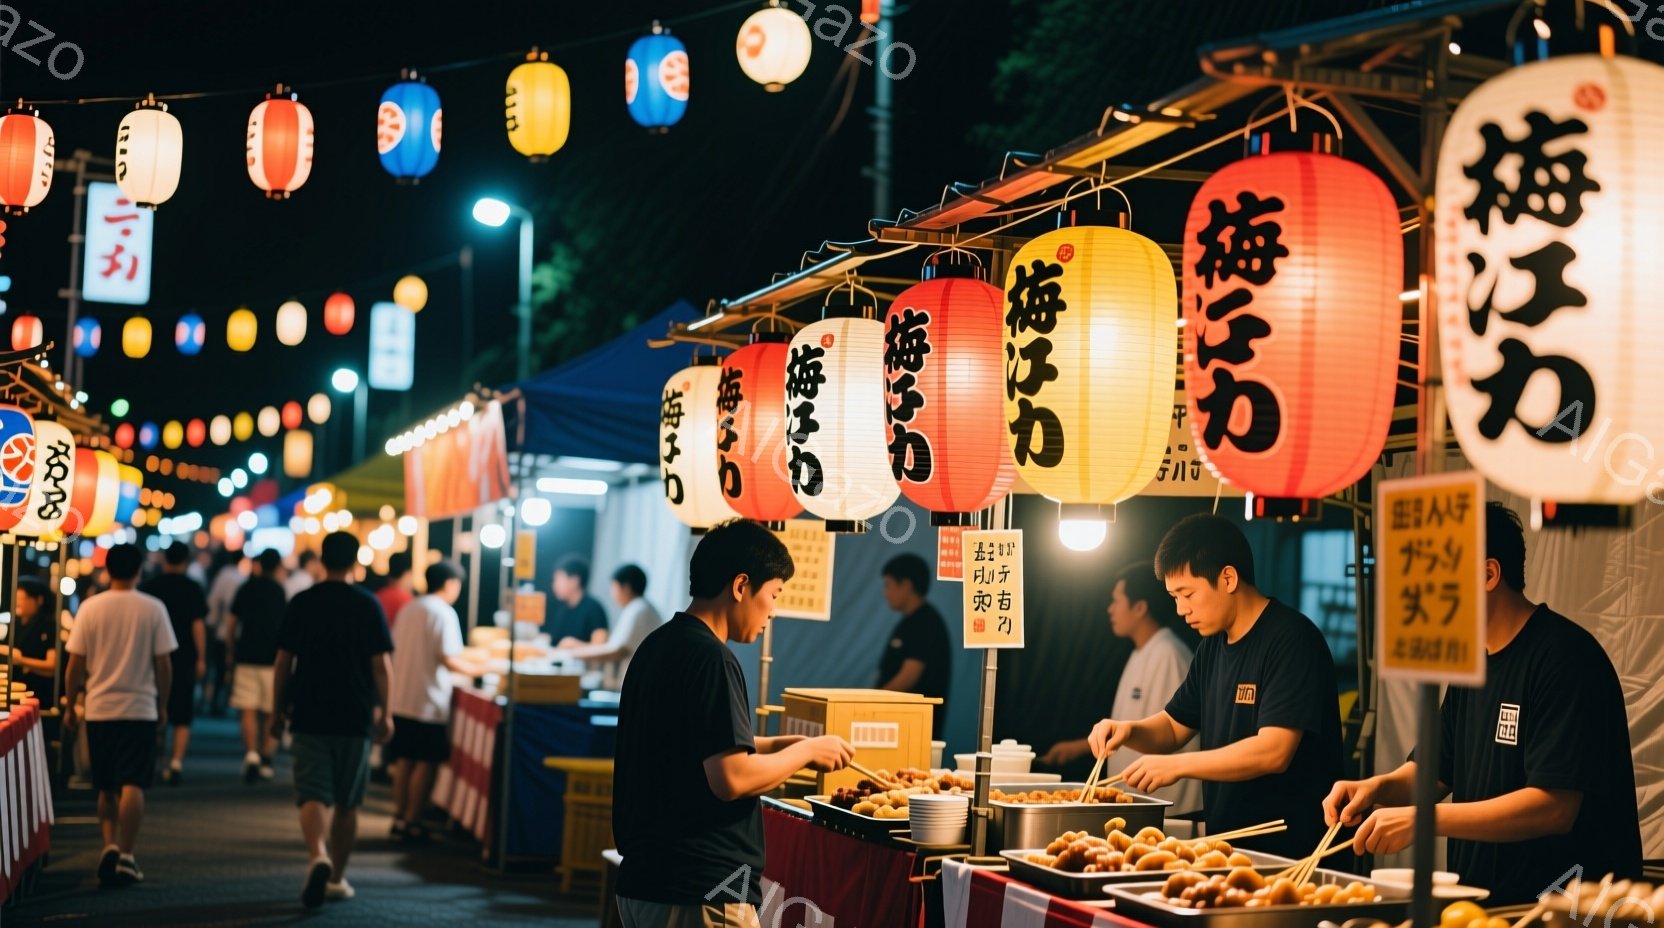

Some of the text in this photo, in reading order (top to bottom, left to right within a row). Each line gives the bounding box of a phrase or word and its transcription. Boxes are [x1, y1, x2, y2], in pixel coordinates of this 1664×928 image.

[1005, 259, 1067, 467] 梅江力
[1195, 191, 1290, 453] 梅江力
[1463, 111, 1601, 443] 梅江力
[785, 344, 826, 496] 梅江力
[884, 308, 931, 482] 梅江力
